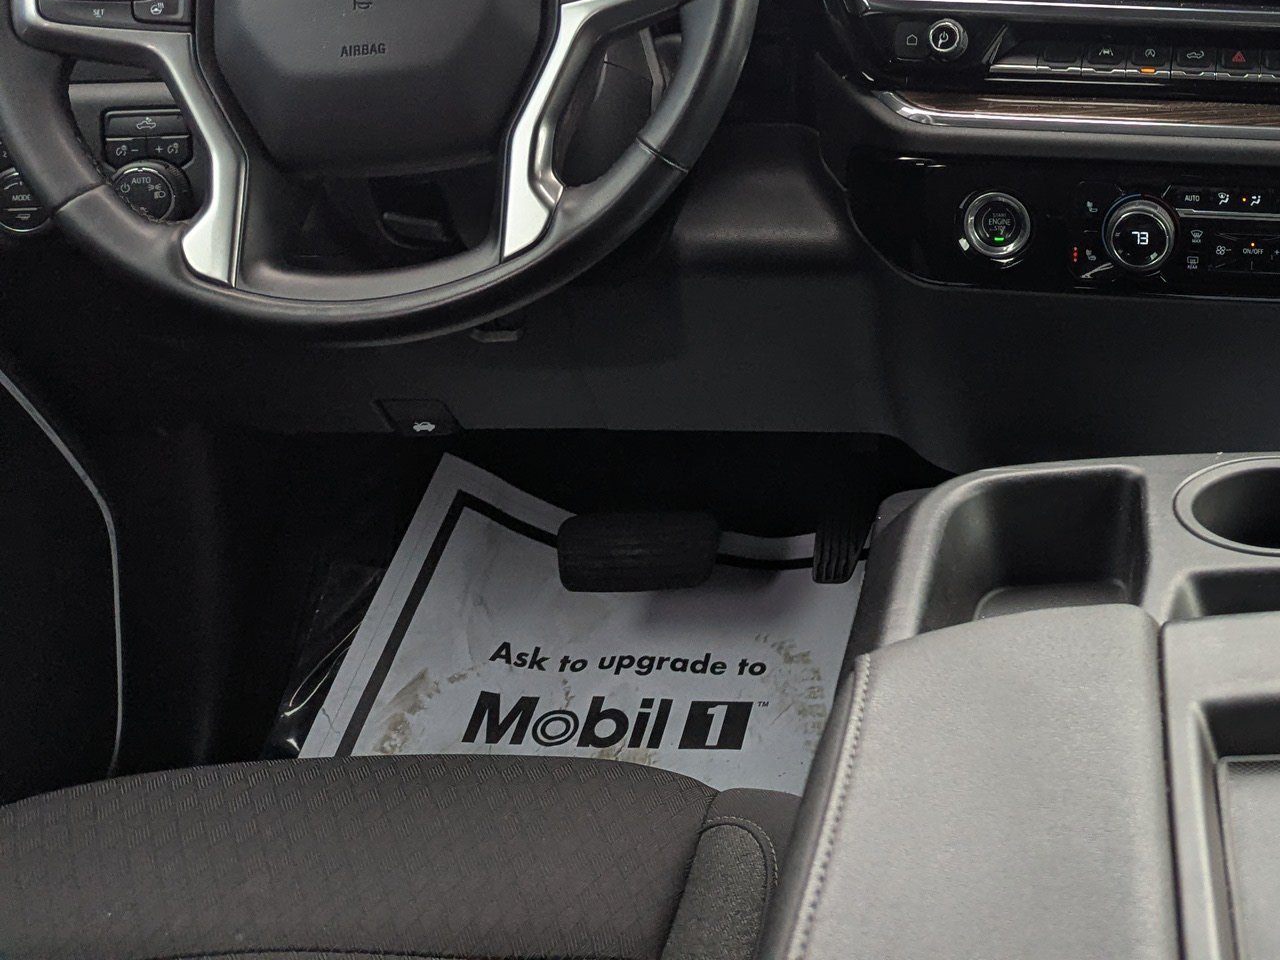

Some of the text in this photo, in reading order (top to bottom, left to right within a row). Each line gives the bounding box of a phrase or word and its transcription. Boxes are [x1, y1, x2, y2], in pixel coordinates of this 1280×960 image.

[340, 42, 386, 57] AIRBAG
[1184, 194, 1200, 202] AUTO
[988, 218, 1011, 226] ENGINE
[1131, 231, 1149, 245] 73
[489, 641, 767, 677] Ask to upgrade to
[461, 690, 674, 750] Mobil
